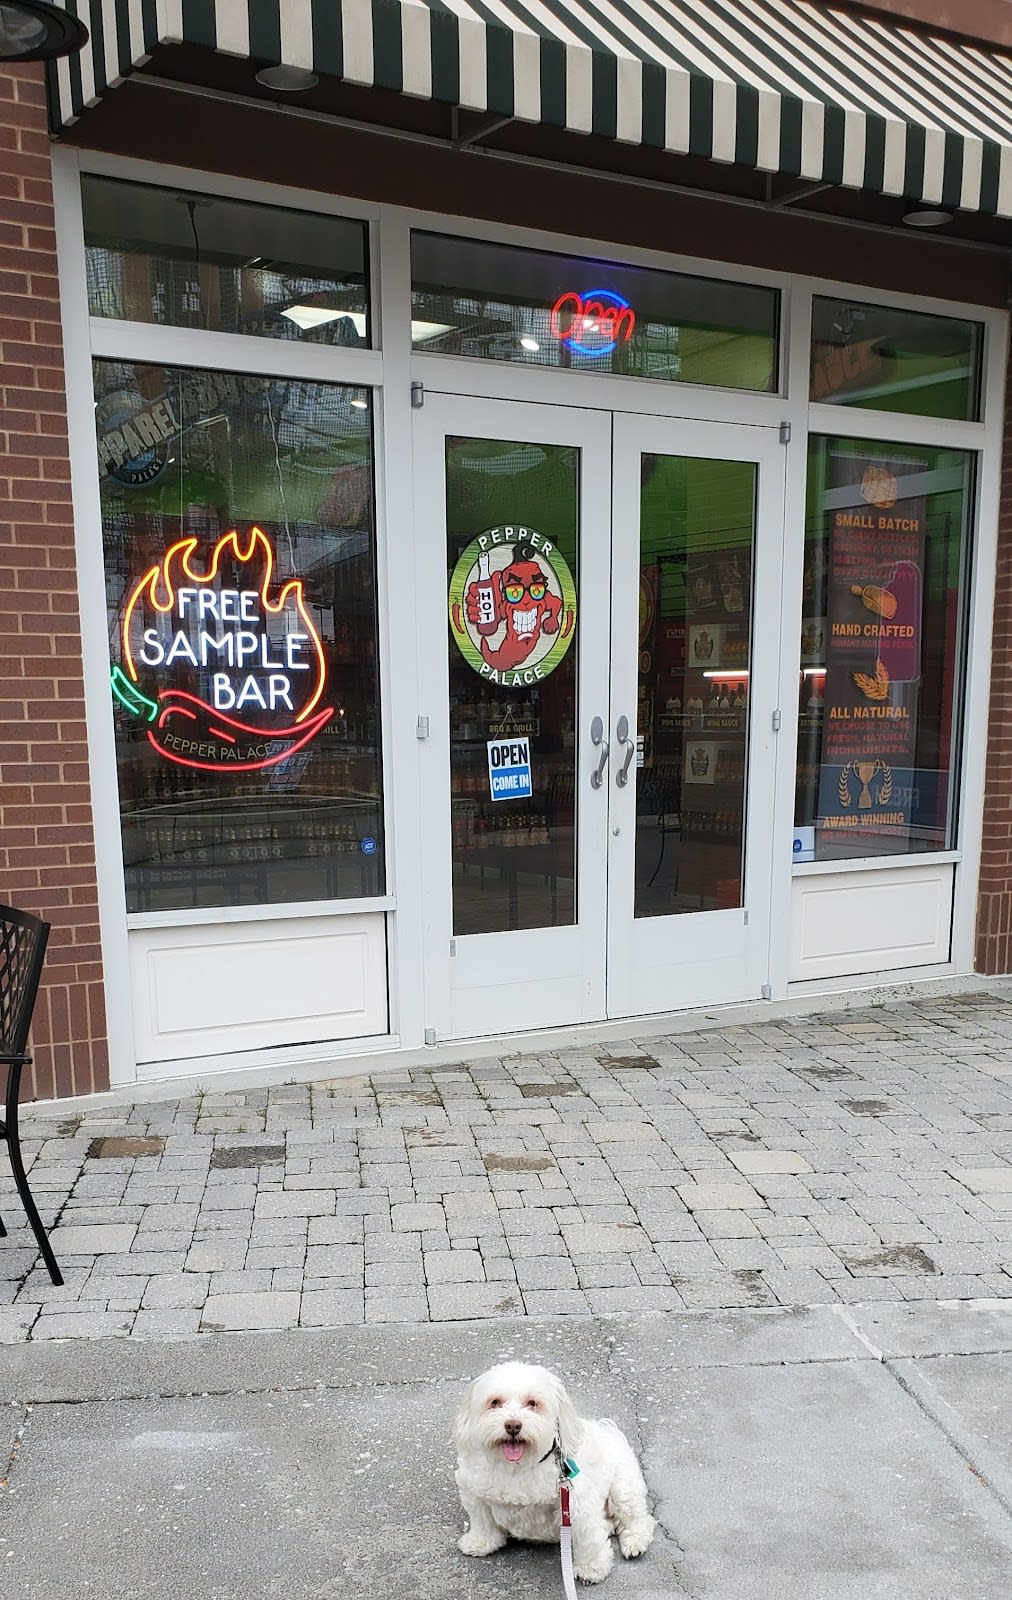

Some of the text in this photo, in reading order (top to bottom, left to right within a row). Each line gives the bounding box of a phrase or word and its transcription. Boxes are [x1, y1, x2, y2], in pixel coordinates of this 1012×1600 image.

[551, 291, 636, 343] Open
[131, 457, 163, 483] PALACE
[835, 513, 919, 531] SMALL BATCH
[478, 526, 553, 557] PEPPER
[177, 588, 260, 621] FREE
[481, 592, 492, 622] HOT
[832, 623, 914, 638] HAND CRAFTED
[140, 628, 310, 669] SAMPLE
[479, 663, 546, 686] PALACE
[213, 673, 294, 711] BAR
[720, 719, 739, 728] SAUCE
[830, 706, 910, 719] ALL NATURAL
[879, 721, 890, 730] TO
[163, 733, 216, 759] PEPPER
[220, 743, 272, 761] PALACE
[490, 743, 528, 768] OPEN
[492, 774, 529, 791] COME IN
[822, 812, 905, 829] AWARD WINNING
